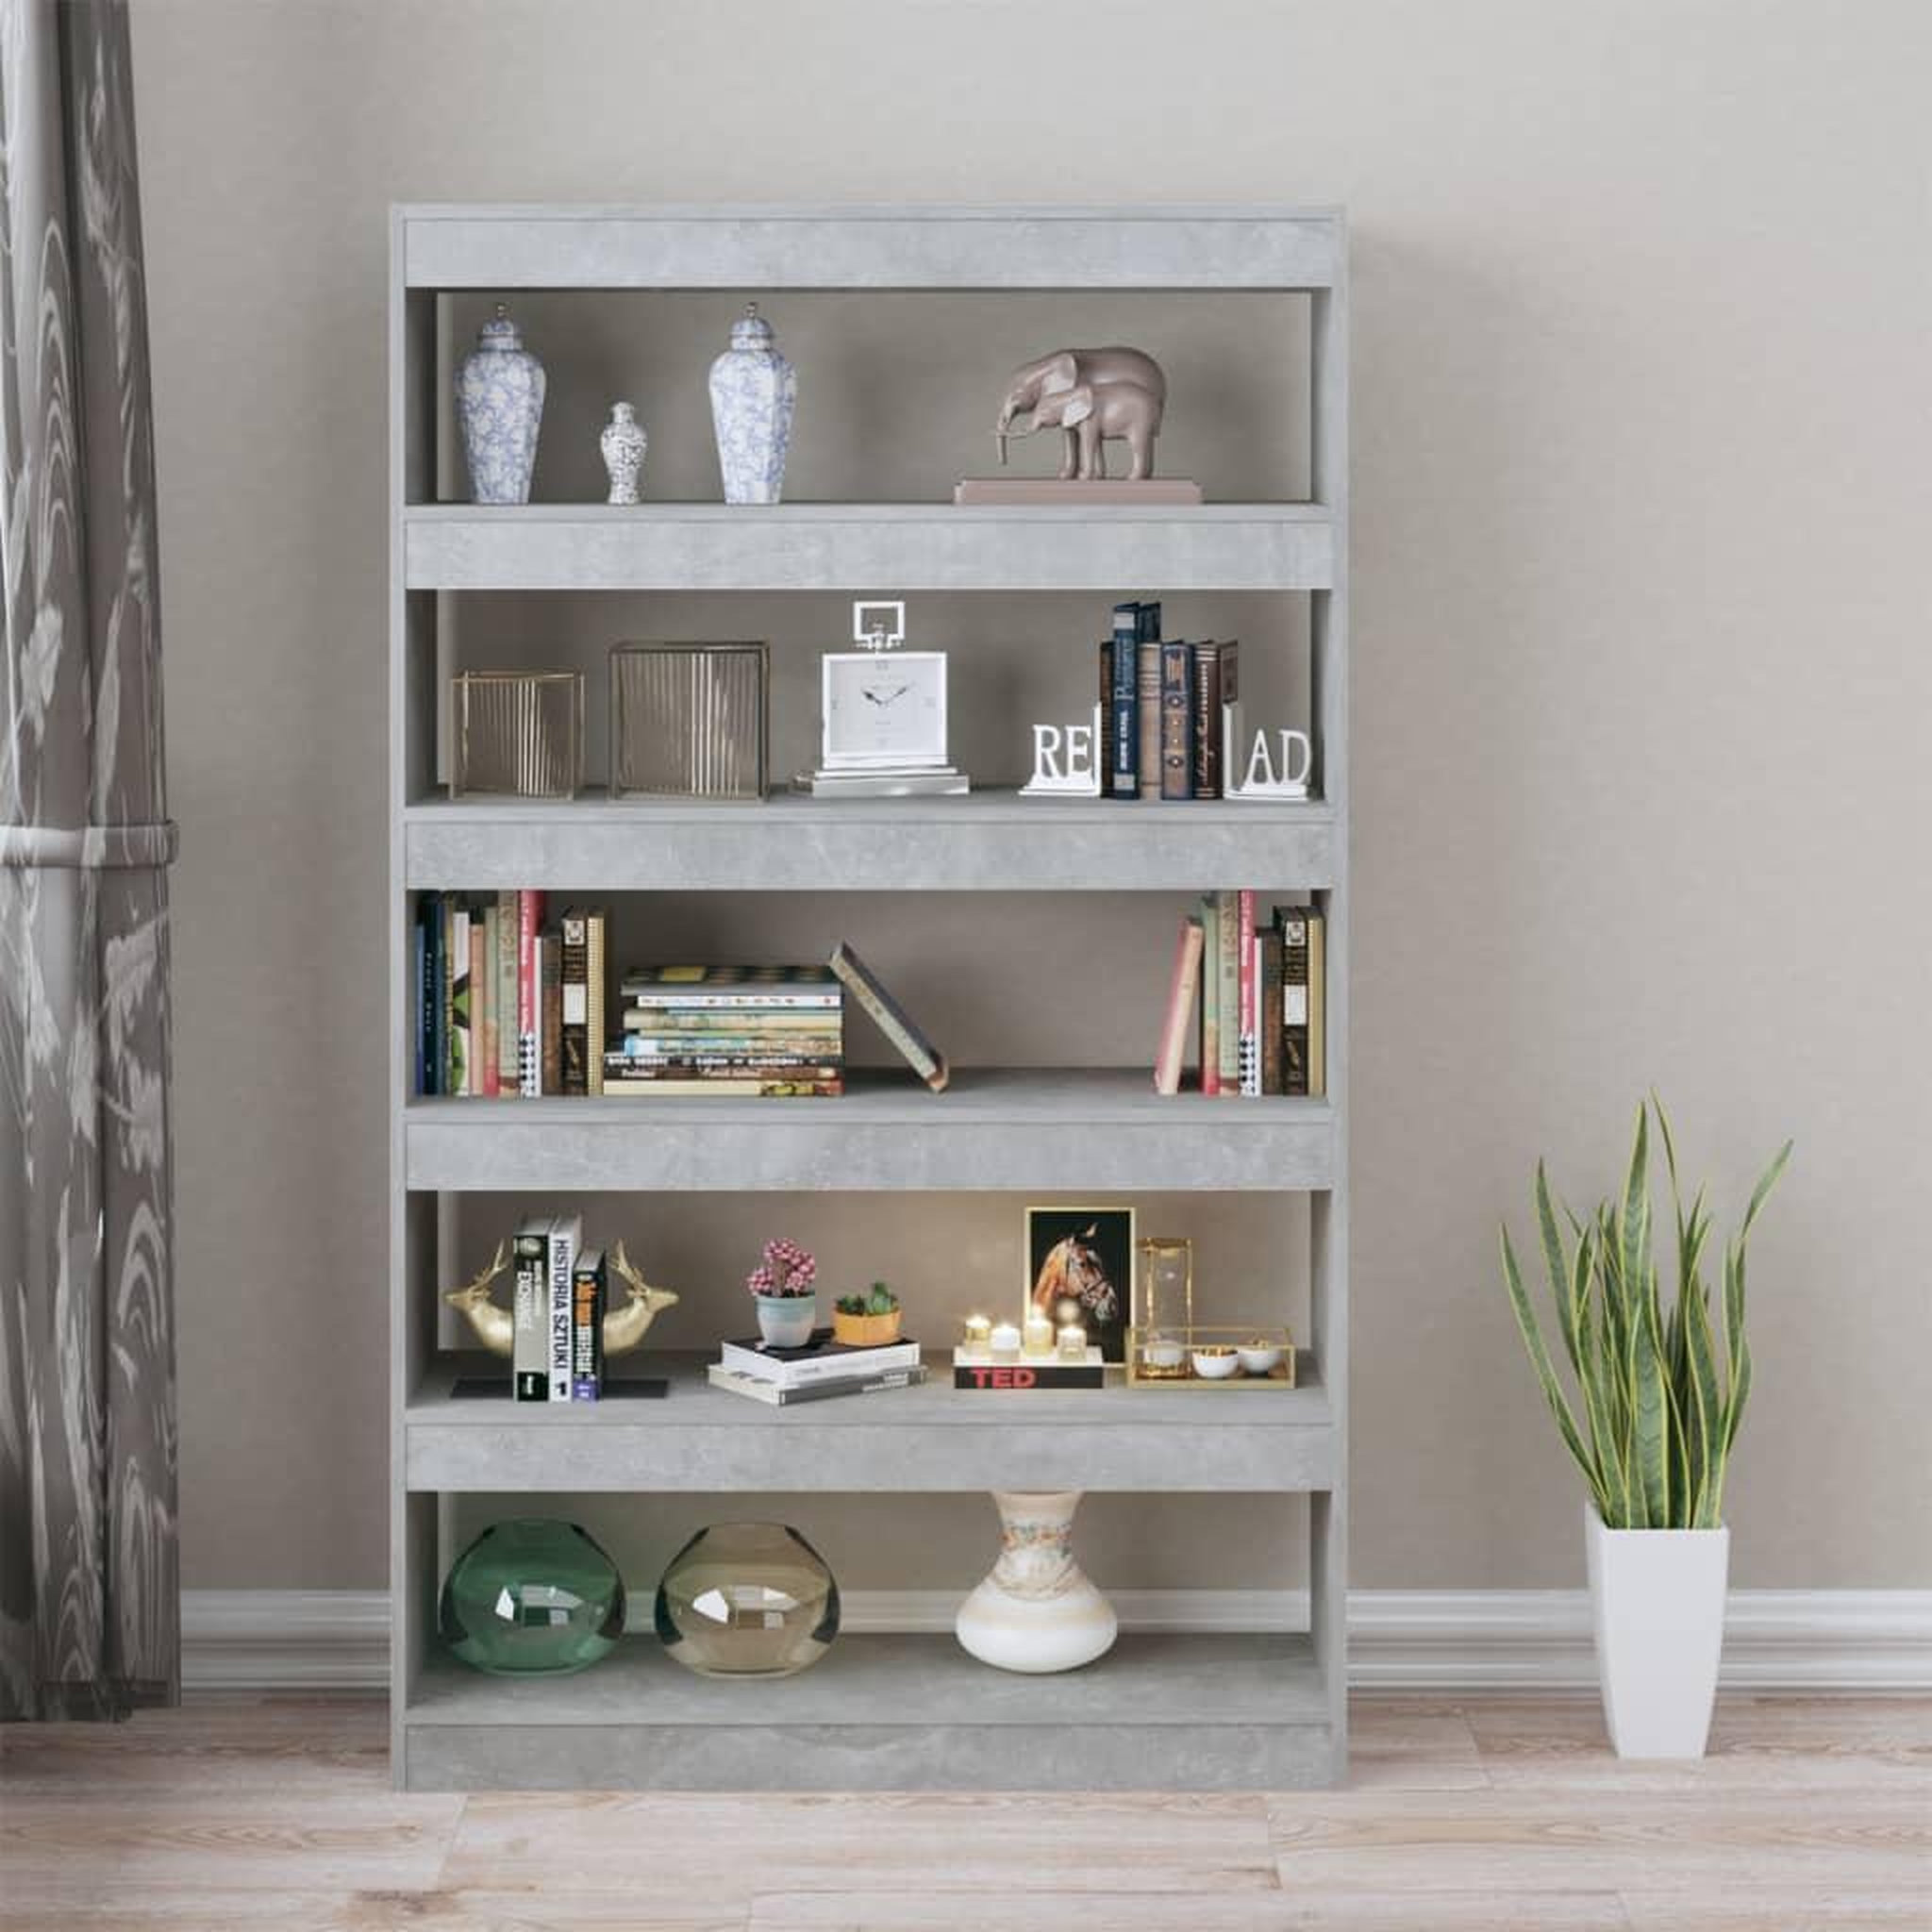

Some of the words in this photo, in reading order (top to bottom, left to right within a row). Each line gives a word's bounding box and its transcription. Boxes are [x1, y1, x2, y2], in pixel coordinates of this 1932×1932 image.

[1033, 724, 1091, 779] RE
[1244, 729, 1312, 785] AD
[554, 1239, 569, 1309] HISTORIA
[553, 1314, 569, 1369] SZTUKI
[972, 1368, 1037, 1389] TED
